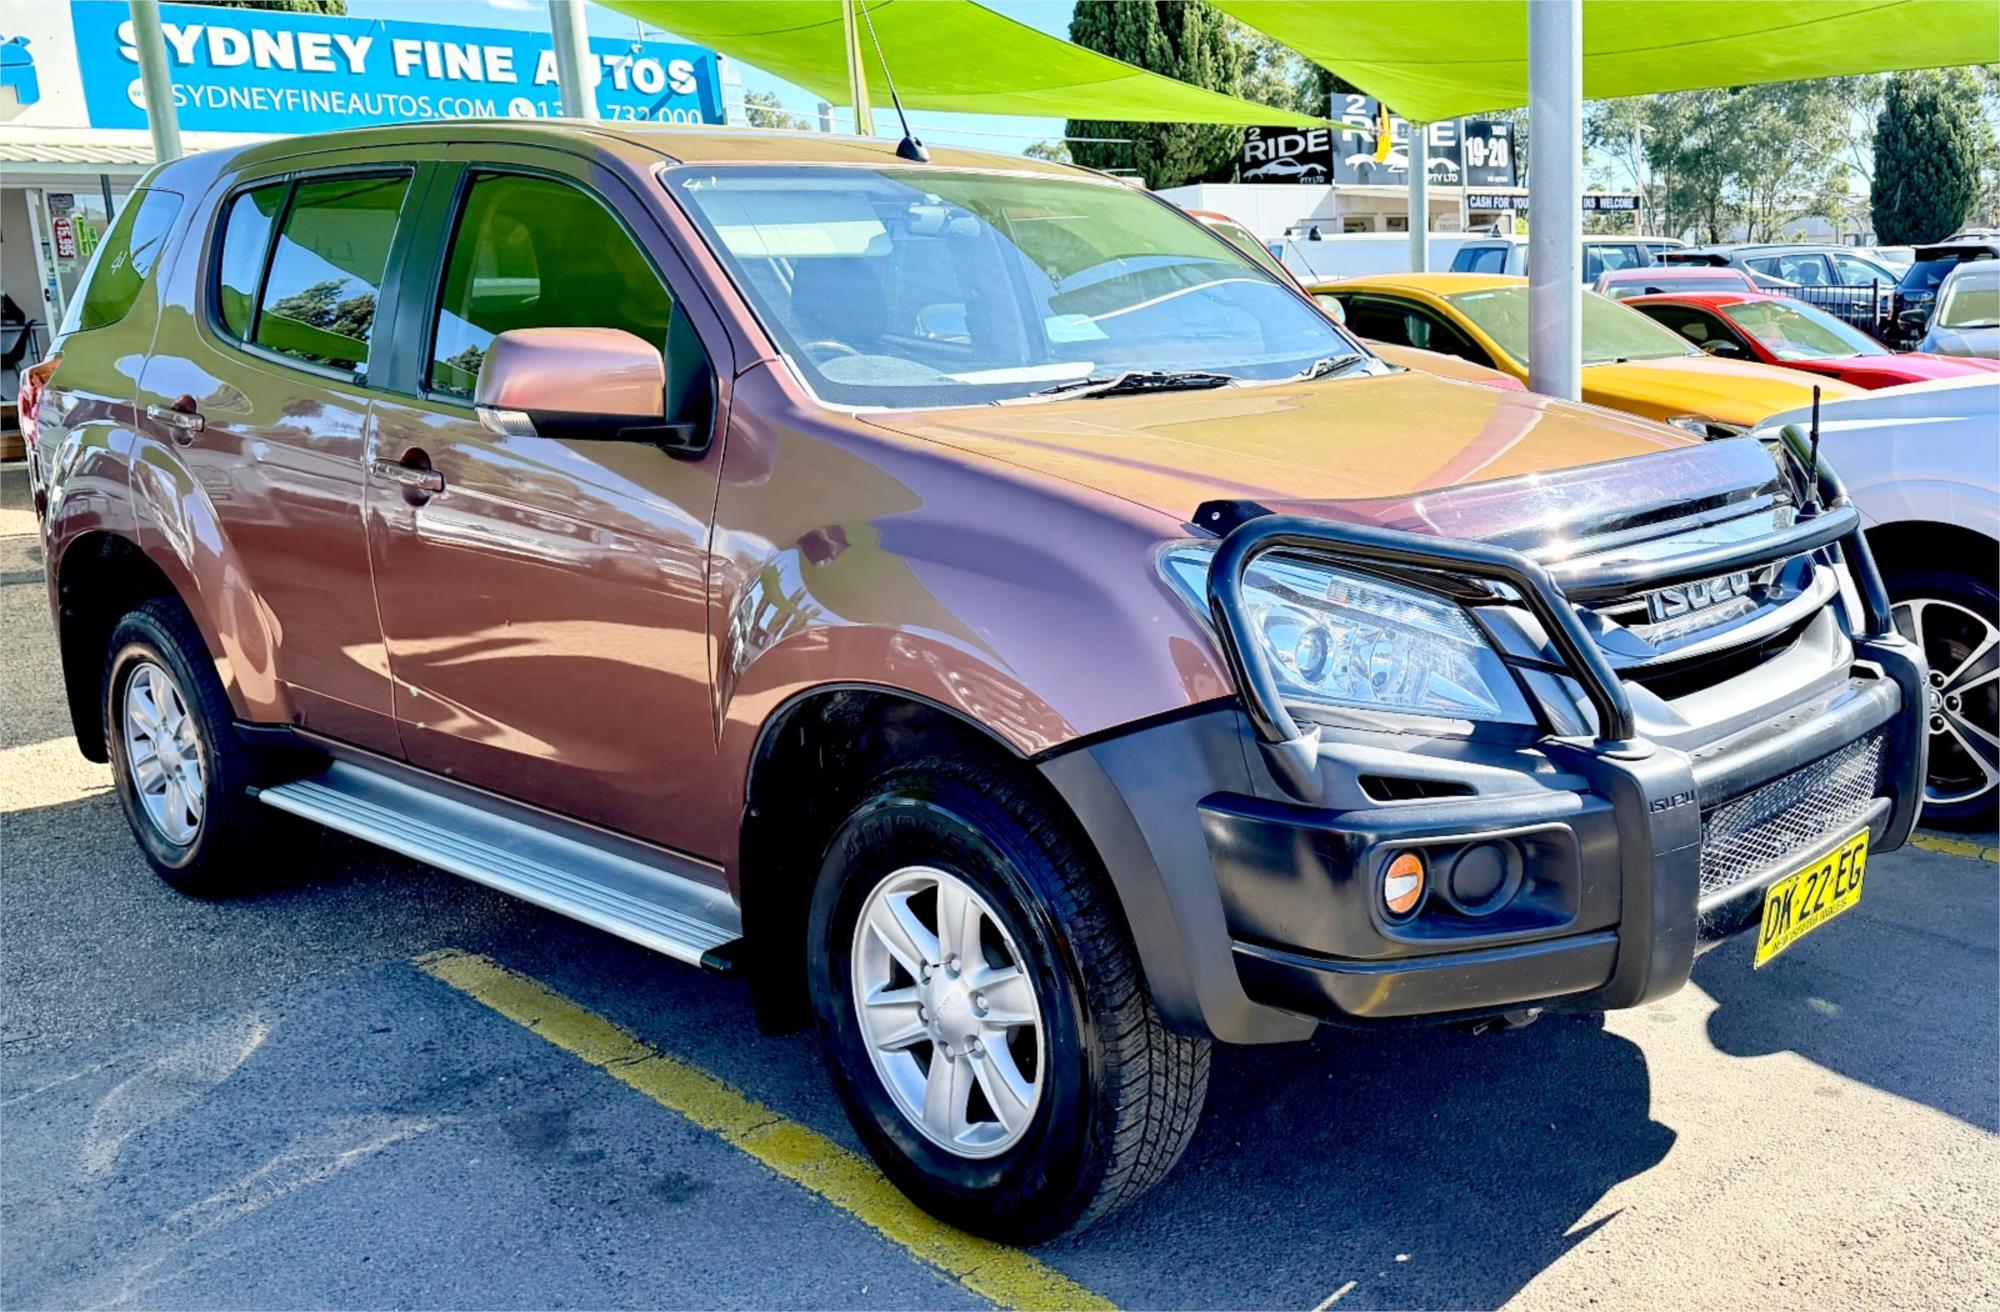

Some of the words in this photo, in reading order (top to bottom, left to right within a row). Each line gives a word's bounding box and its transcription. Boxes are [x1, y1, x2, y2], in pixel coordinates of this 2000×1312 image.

[118, 20, 373, 73] SYDNEY
[392, 38, 518, 83] FINE
[534, 48, 697, 95] ATOS
[172, 83, 496, 119] SYDNEYFINEAUTOS.COM
[1345, 94, 1367, 114] 2
[1244, 129, 1330, 163] RIDE
[1248, 127, 1261, 141] 2
[1466, 136, 1508, 168] 19-20
[1443, 173, 1458, 183] LTD
[1469, 196, 1492, 208] CASH
[1494, 197, 1509, 209] FOR
[1599, 197, 1635, 209] WELCOME
[1648, 572, 1750, 621] ISUZU
[1649, 790, 1695, 814] ISUZU
